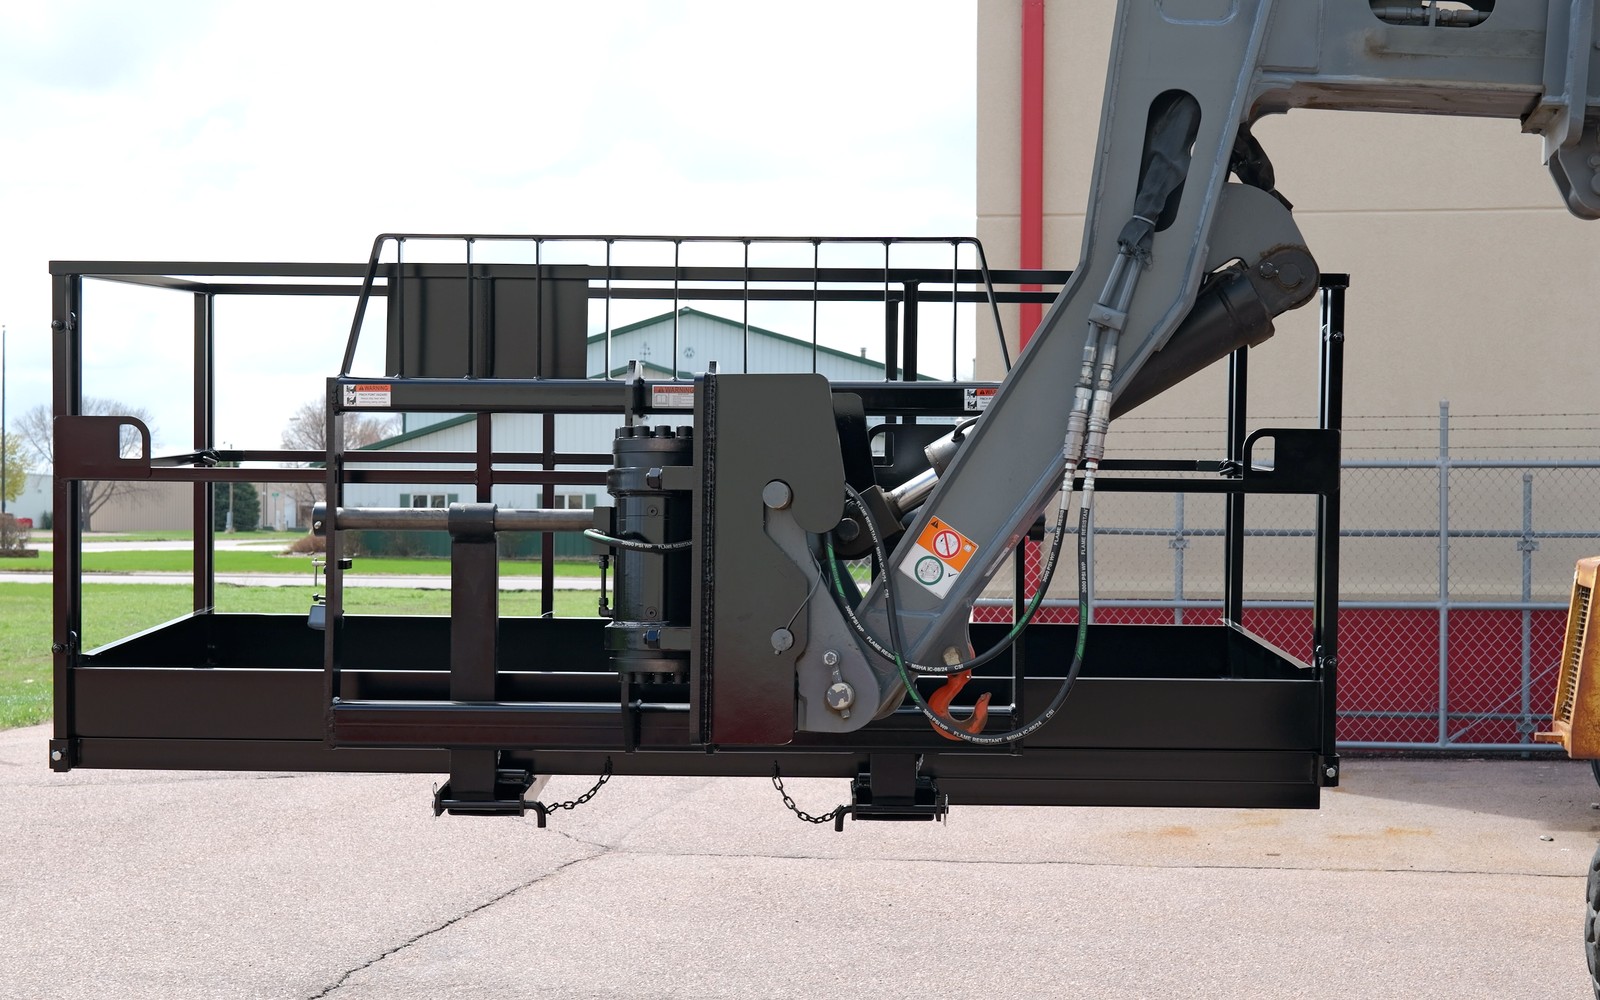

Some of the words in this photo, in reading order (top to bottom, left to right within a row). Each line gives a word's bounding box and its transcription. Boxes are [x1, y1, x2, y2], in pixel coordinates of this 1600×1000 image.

[856, 501, 868, 516] FLAME
[865, 516, 878, 544] RESISTANT
[1043, 571, 1051, 583] 3000
[1049, 551, 1056, 562] WP
[1054, 526, 1062, 546] FLAME
[1081, 561, 1086, 571] WP
[844, 605, 854, 617] 3000
[851, 615, 859, 627] PSI
[856, 623, 865, 633] WP
[866, 635, 882, 652] FLAME
[911, 663, 927, 672] MSHA
[953, 731, 972, 742] FLAME
[972, 736, 1003, 744] RESISTANT
[1006, 732, 1023, 742] MSHA
[1045, 708, 1055, 718] CSI
